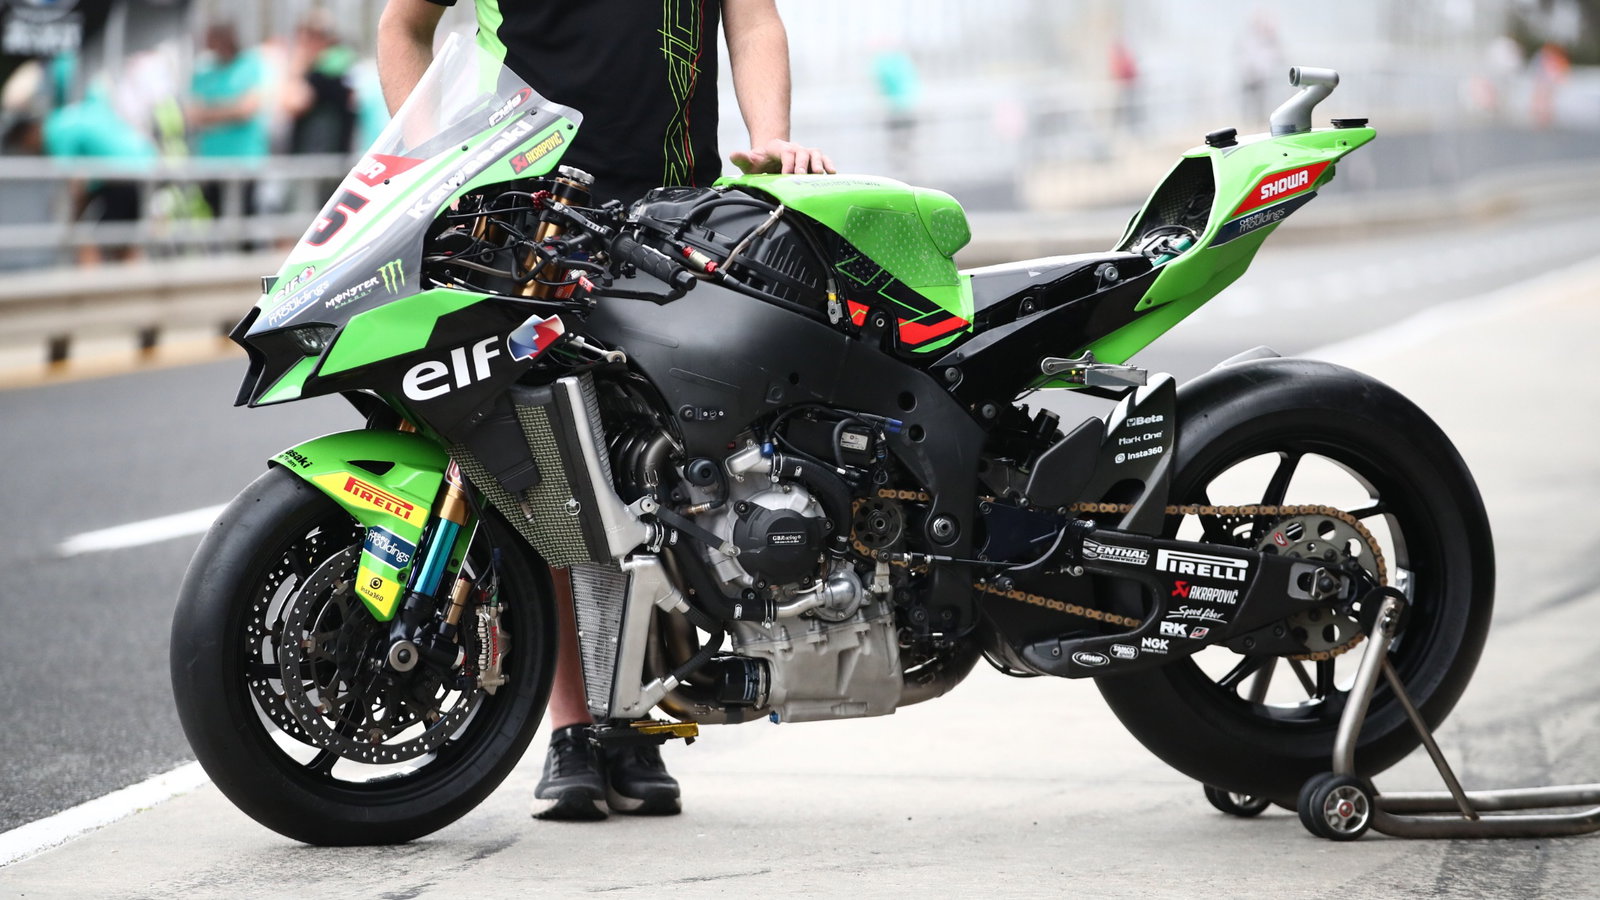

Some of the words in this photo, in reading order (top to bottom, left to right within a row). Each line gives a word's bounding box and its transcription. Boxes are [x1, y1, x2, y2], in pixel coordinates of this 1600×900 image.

[1260, 170, 1309, 200] SHOWA
[402, 335, 502, 401] elf
[1136, 414, 1163, 426] Beta
[1118, 435, 1141, 445] Mark
[1127, 446, 1163, 460] Insta360
[343, 476, 414, 520] PIRELLI
[368, 531, 410, 563] mouldings
[1155, 549, 1249, 582] PIRELLI
[1160, 620, 1187, 635] RK
[1141, 637, 1170, 650] NGK
